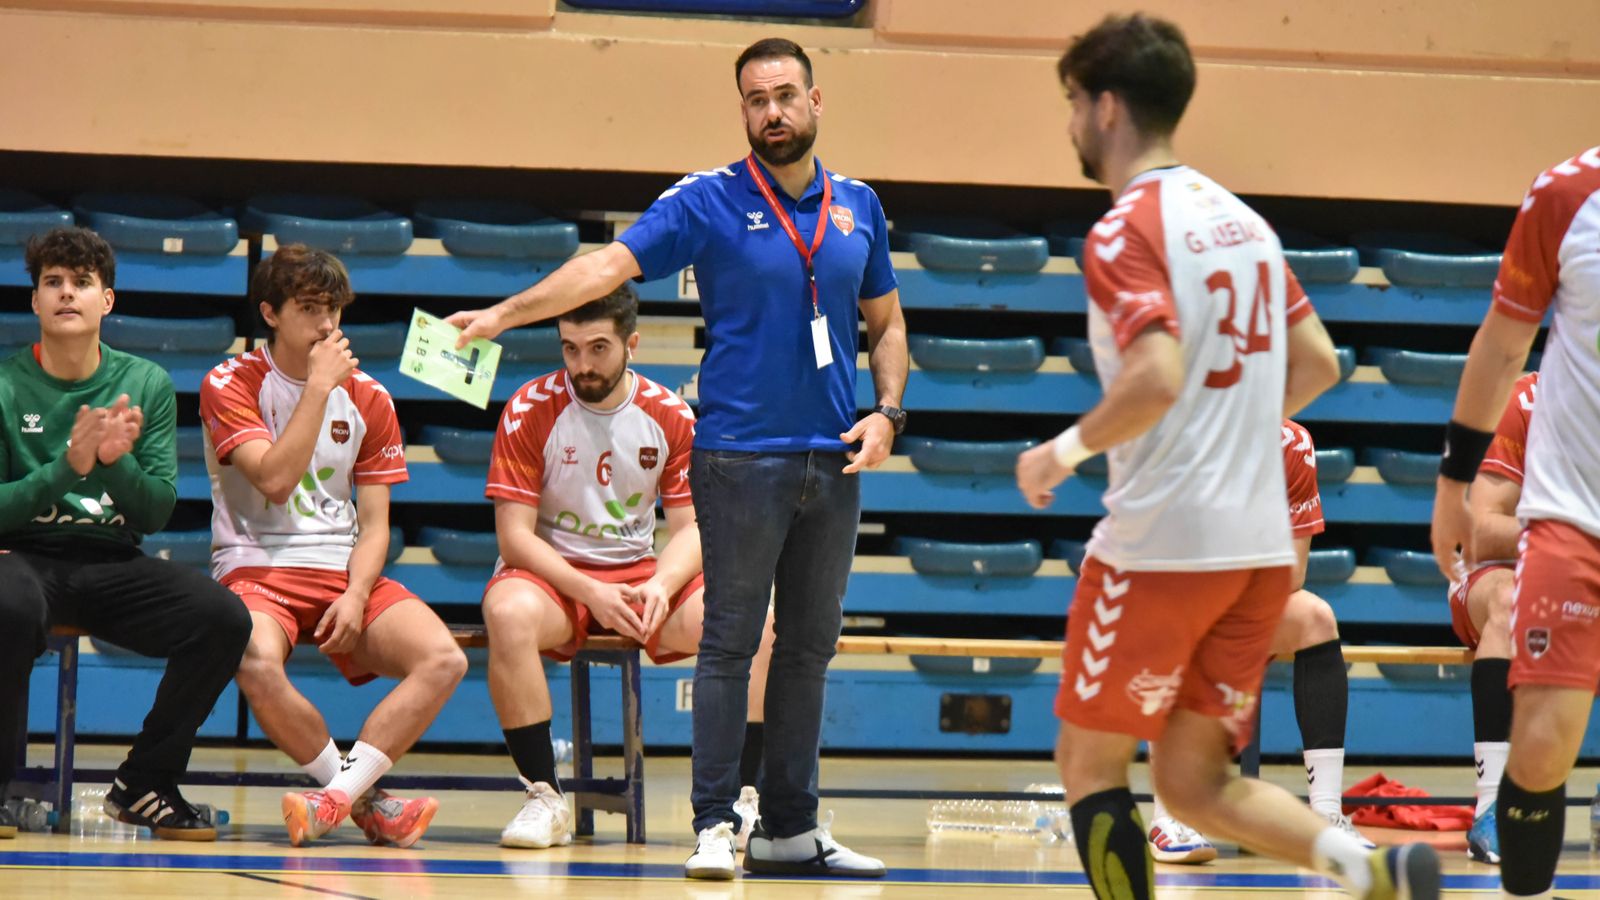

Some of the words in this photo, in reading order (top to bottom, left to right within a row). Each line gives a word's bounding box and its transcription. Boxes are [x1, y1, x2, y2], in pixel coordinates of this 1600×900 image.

[1203, 260, 1272, 389] 34
[440, 347, 480, 385] T
[596, 450, 613, 487] 6
